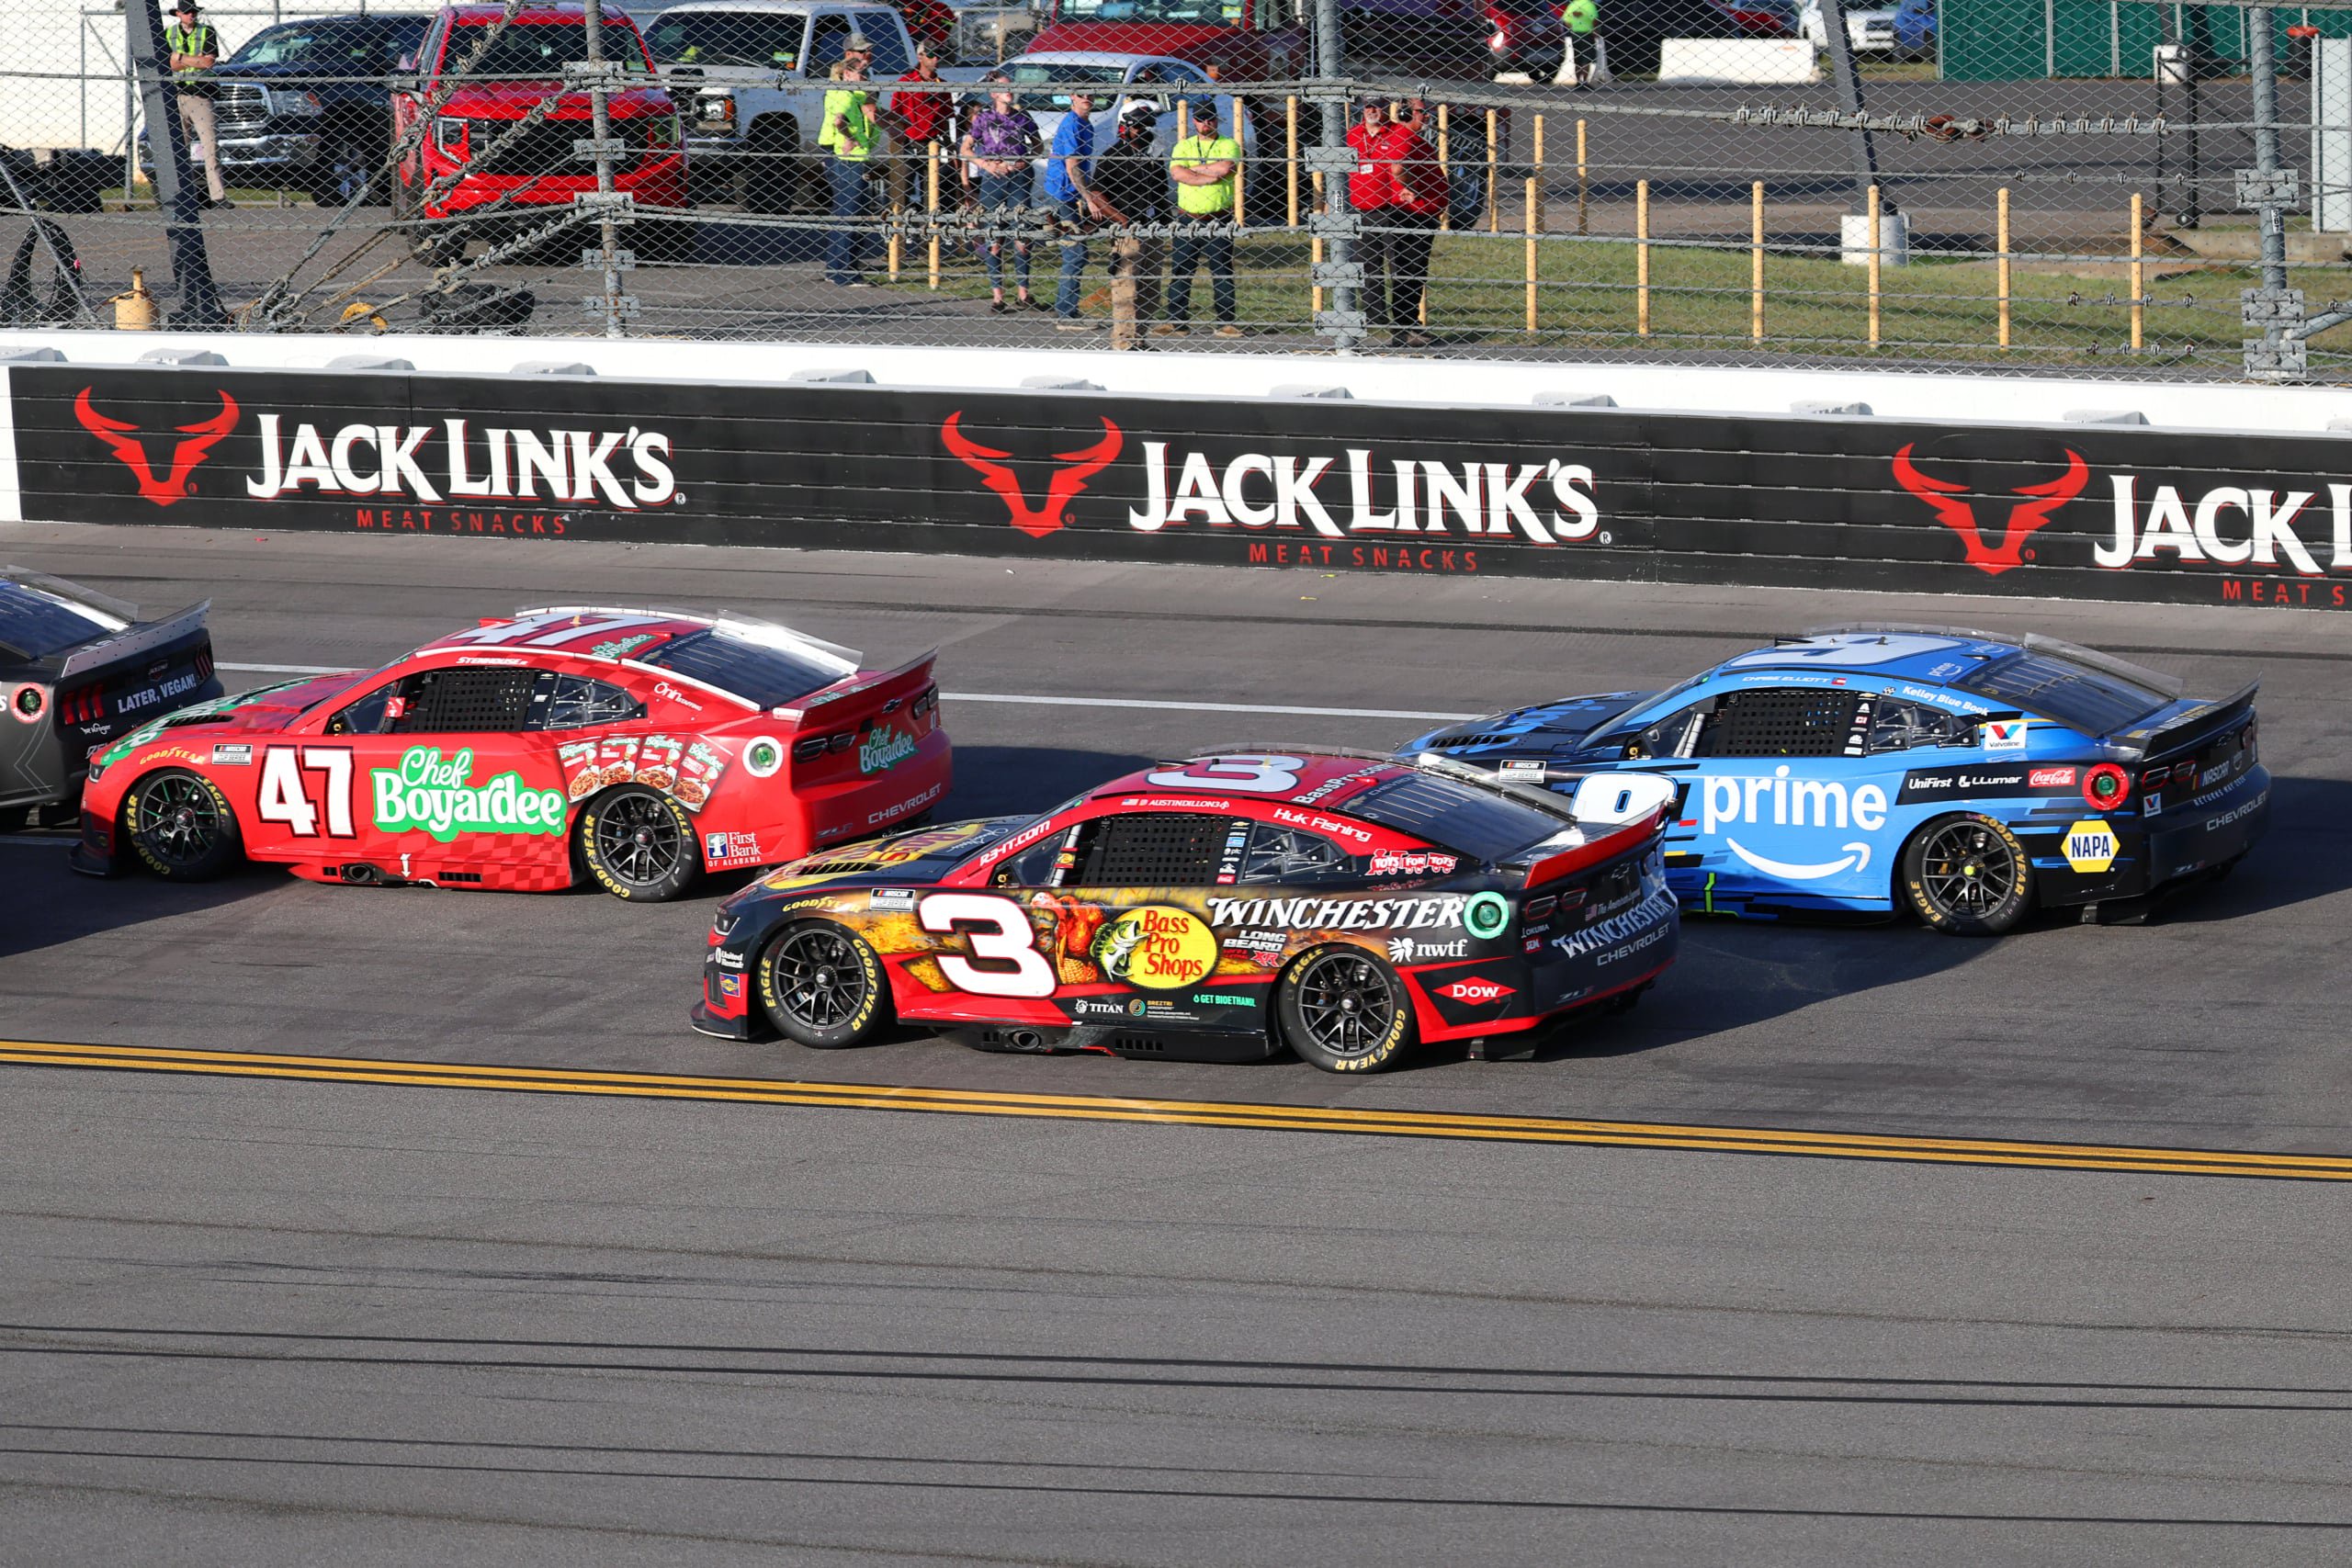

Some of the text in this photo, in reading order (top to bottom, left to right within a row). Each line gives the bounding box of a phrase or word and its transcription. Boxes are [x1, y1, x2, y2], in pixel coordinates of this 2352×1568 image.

[246, 413, 676, 508] JACK LINK'S
[1129, 442, 1601, 544] JACK LINK'S
[357, 509, 567, 535] MEAT SNACKS
[2094, 474, 2325, 575] JACK
[1250, 544, 1478, 571] MEAT SNACKS
[2222, 580, 2311, 604] MEAT
[118, 673, 197, 714] LATER, VEGAN!
[1785, 676, 1831, 684] ELLIOTT
[1903, 685, 1991, 716] Kelley Blue Book
[140, 746, 205, 765] GOODYEAR
[860, 732, 915, 773] Boyardee
[1989, 740, 2020, 749] Valvoline
[401, 748, 471, 790] Chef
[1909, 777, 1952, 790] UniFirst
[2030, 769, 2074, 786] Coca-Cola
[202, 778, 229, 817] EAGLE
[255, 744, 357, 840] 47
[373, 773, 562, 832] Boyardee
[867, 784, 942, 825] CHEVROLET
[1704, 764, 1888, 835] prime
[664, 798, 690, 837] EAGLE
[1272, 807, 1373, 843] Huk Fishing
[2206, 790, 2267, 831] CHEVROLET
[728, 830, 757, 844] First
[729, 842, 763, 858] Bank
[2071, 834, 2111, 859] NAPA
[583, 814, 631, 897] GOODYEAR
[708, 856, 762, 867] OF ALABAMA
[1374, 854, 1455, 869] TOYS FOR TOTS
[1978, 815, 2028, 897] GOODYEAR
[783, 895, 861, 912] GOODYER
[1206, 896, 1465, 930] WINCHESTER
[1910, 880, 1942, 923] EAGLE
[1142, 909, 1190, 934] Bass
[1239, 930, 1287, 942] LONG
[1551, 891, 1674, 959] WINCHESTER
[920, 893, 1058, 999] 3
[1147, 931, 1182, 954] Pro
[1223, 938, 1283, 952] BEARD
[1417, 939, 1466, 958] nwtf
[1597, 921, 1670, 966] CHEVROLET
[762, 955, 775, 1009] EAGLE
[1144, 952, 1204, 982] Shops
[1288, 947, 1324, 986] EAGLE
[852, 938, 878, 1032] GOODYEAR
[1200, 994, 1214, 1004] GET
[1089, 1002, 1124, 1015] TITAN
[1334, 1009, 1408, 1072] GOODYEAR
